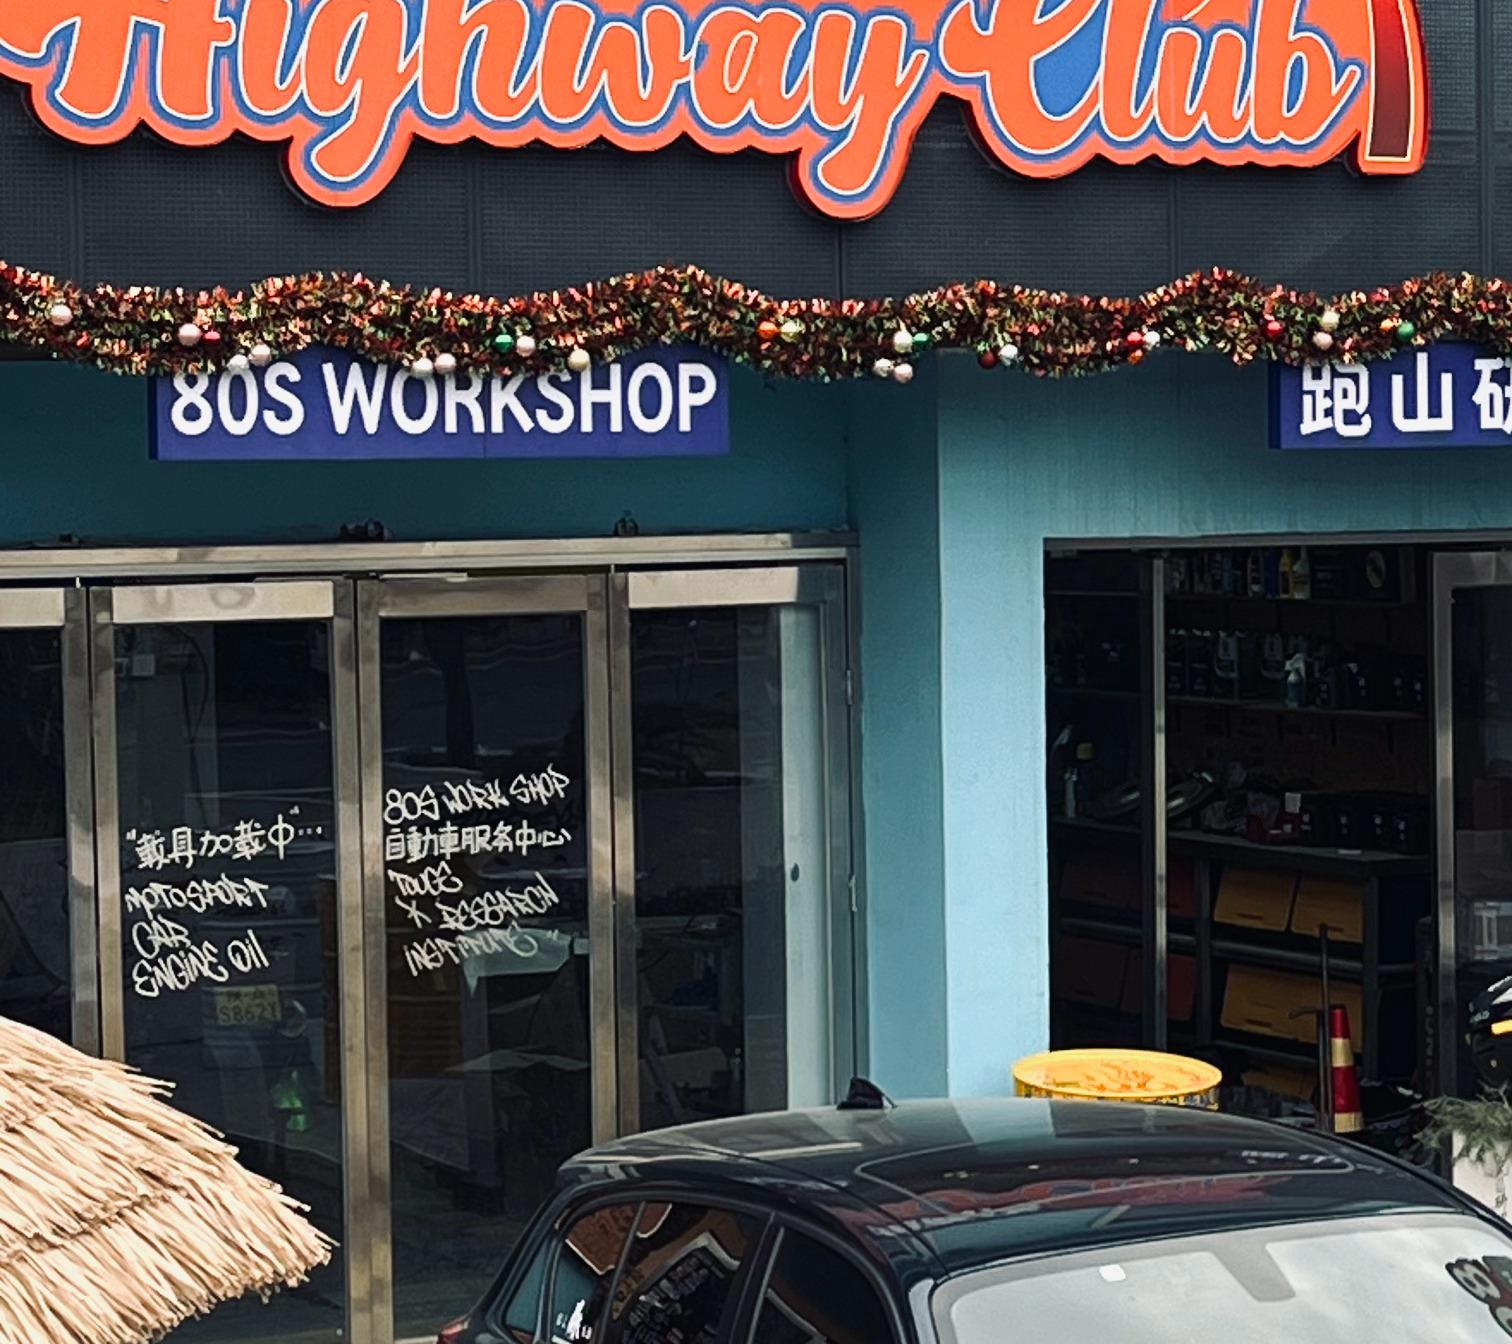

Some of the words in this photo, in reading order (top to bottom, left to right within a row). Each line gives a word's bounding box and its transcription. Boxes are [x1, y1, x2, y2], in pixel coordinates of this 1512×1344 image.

[171, 361, 304, 435] 80S
[322, 362, 717, 435] WORKSHOP
[384, 785, 440, 825] 80S
[509, 763, 570, 806] SHOP
[132, 914, 192, 959] CAR
